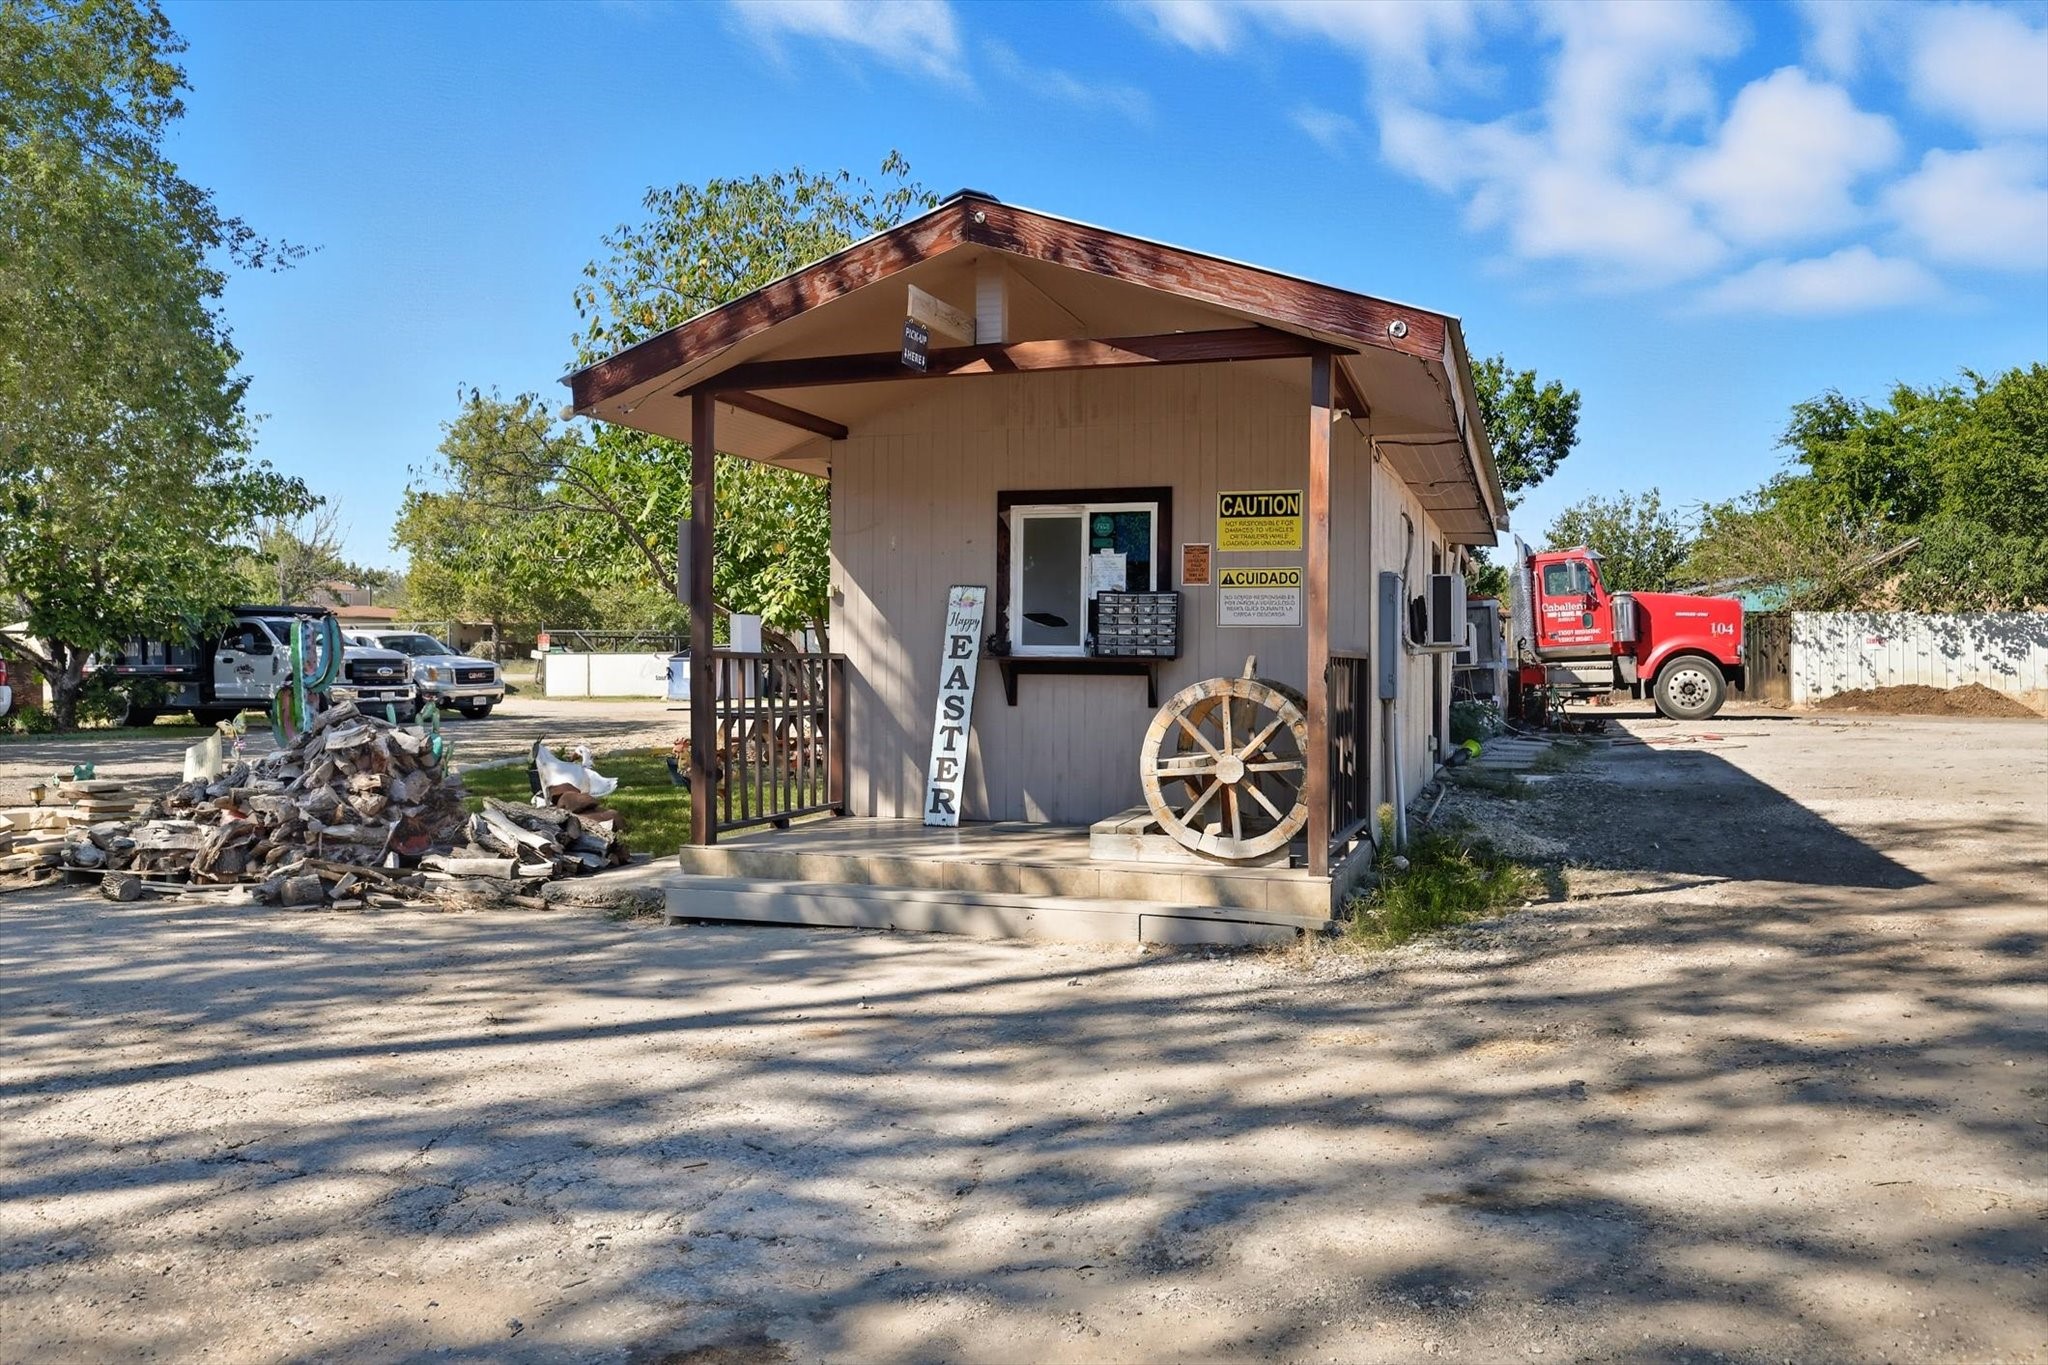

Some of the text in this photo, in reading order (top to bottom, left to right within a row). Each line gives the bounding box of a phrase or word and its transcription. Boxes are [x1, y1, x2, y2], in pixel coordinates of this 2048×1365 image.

[907, 350, 922, 365] HERE
[1221, 495, 1298, 516] CAUTION
[1236, 572, 1299, 585] CUIDADO
[948, 611, 980, 632] Happy
[1711, 622, 1734, 635] 104
[929, 635, 973, 814] EASTER
